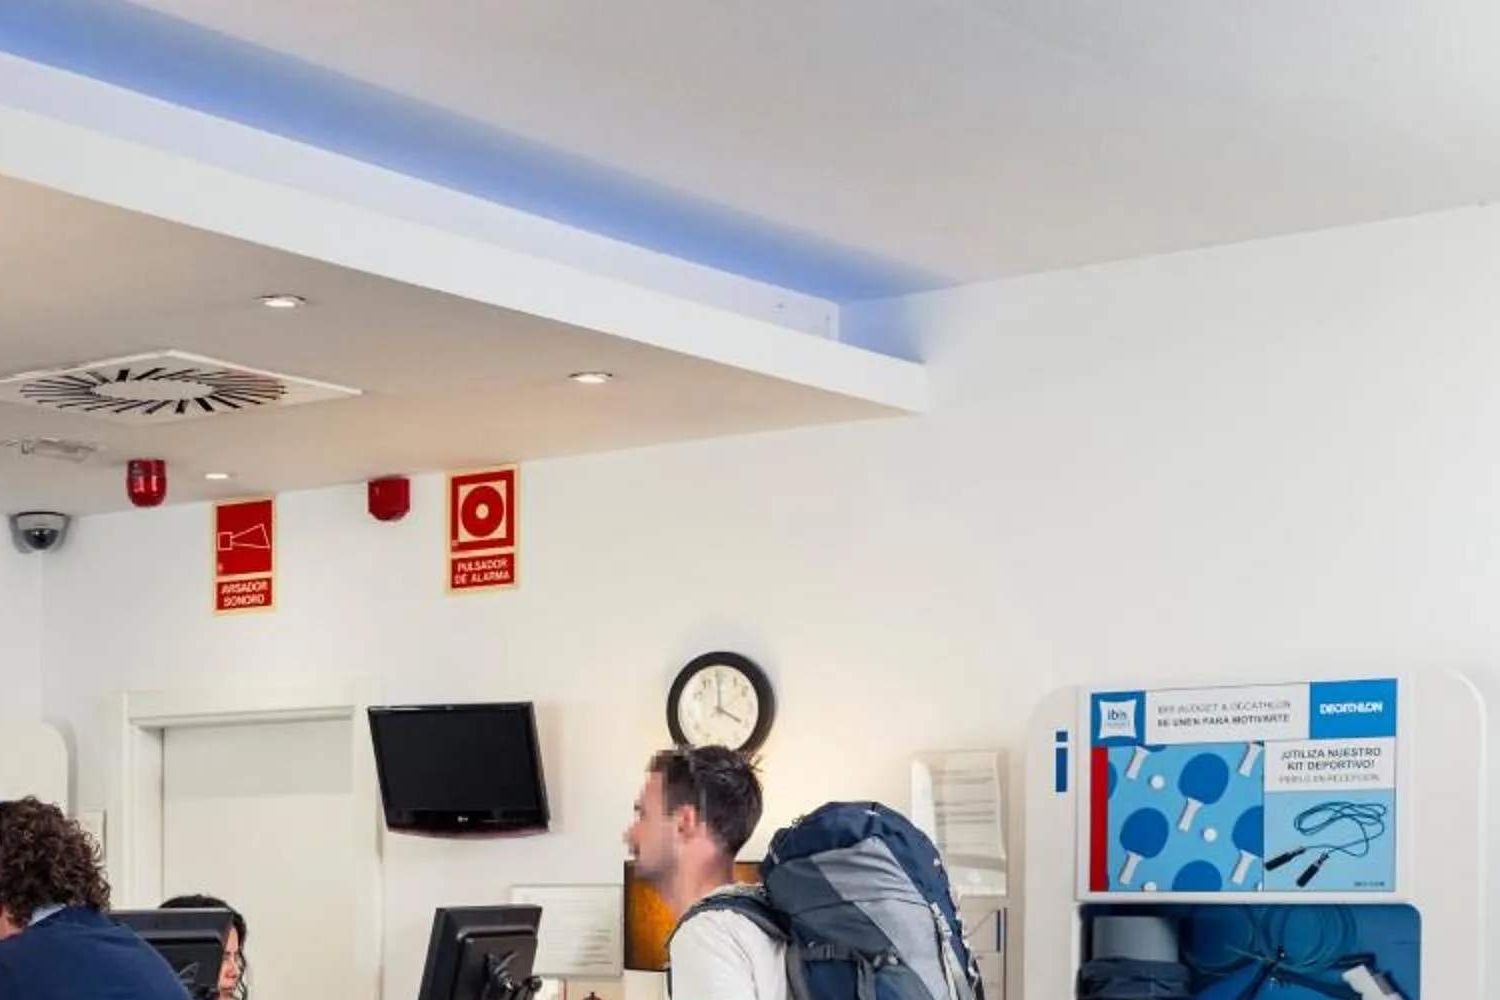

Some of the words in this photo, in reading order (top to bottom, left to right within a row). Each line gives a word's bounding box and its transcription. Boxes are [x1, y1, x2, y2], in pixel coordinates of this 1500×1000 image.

[457, 558, 508, 573] PULSADOR
[454, 573, 468, 584] DE
[471, 570, 511, 582] ALARMA
[222, 580, 268, 595] AVISADOR
[223, 593, 265, 607] SONORO
[1319, 701, 1383, 715] DECATHLON
[1328, 747, 1381, 758] NUESTRO
[1287, 762, 1304, 771] KIT
[1307, 760, 1375, 771] DEPORTIVO!
